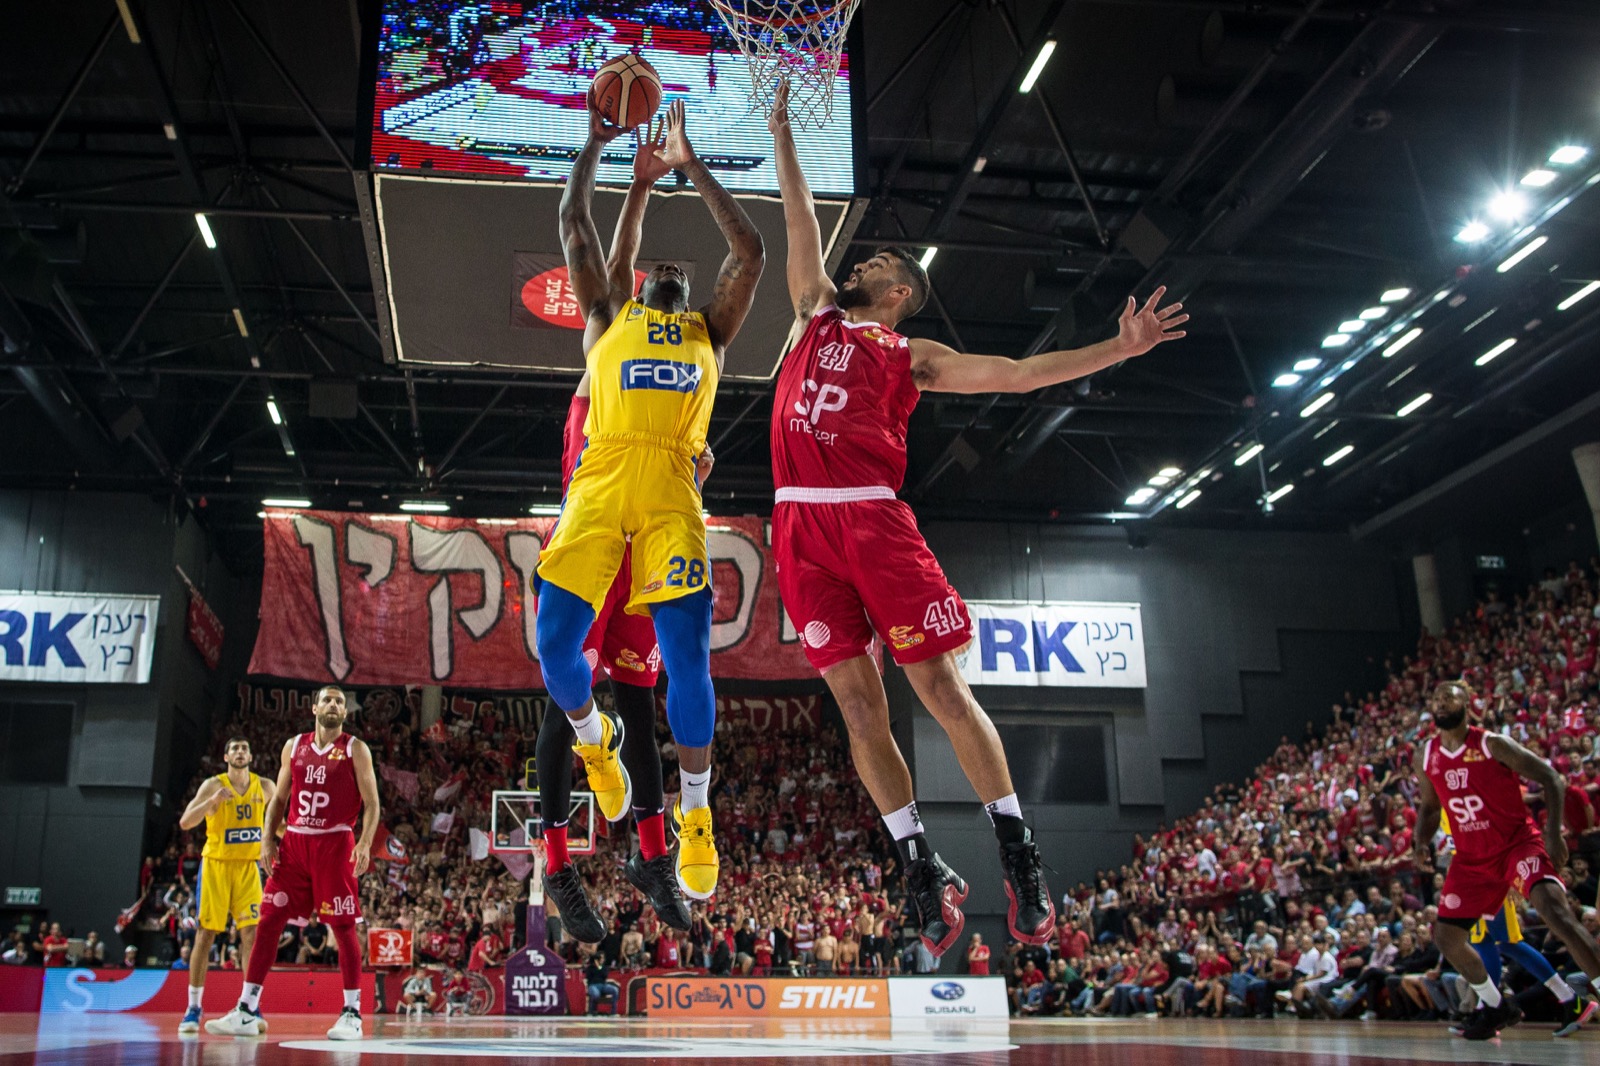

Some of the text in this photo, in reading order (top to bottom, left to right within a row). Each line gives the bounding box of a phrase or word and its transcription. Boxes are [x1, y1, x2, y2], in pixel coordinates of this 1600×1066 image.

[648, 322, 682, 345] 28
[818, 341, 855, 372] 41
[629, 363, 703, 390] FOX
[665, 555, 705, 588] 28
[92, 614, 146, 639] רענן
[922, 595, 966, 637] 41
[978, 617, 1086, 673] RK
[1083, 621, 1134, 646] רענן
[100, 644, 134, 671] כץ
[1096, 651, 1127, 676] כץ
[304, 764, 326, 784] 14
[1444, 768, 1469, 790] 97
[236, 804, 252, 820] 50
[298, 790, 330, 817] SP
[1448, 795, 1484, 823] SP
[228, 829, 261, 842] FOX
[1516, 856, 1540, 880] 97
[250, 903, 260, 919] 5
[334, 896, 356, 916] 14
[511, 972, 557, 989] דלתות
[511, 989, 558, 1008] תבור
[651, 983, 692, 1009] SIG
[719, 983, 765, 1010] סיג
[779, 985, 875, 1009] STIHL
[925, 1006, 976, 1014] SUBARU
